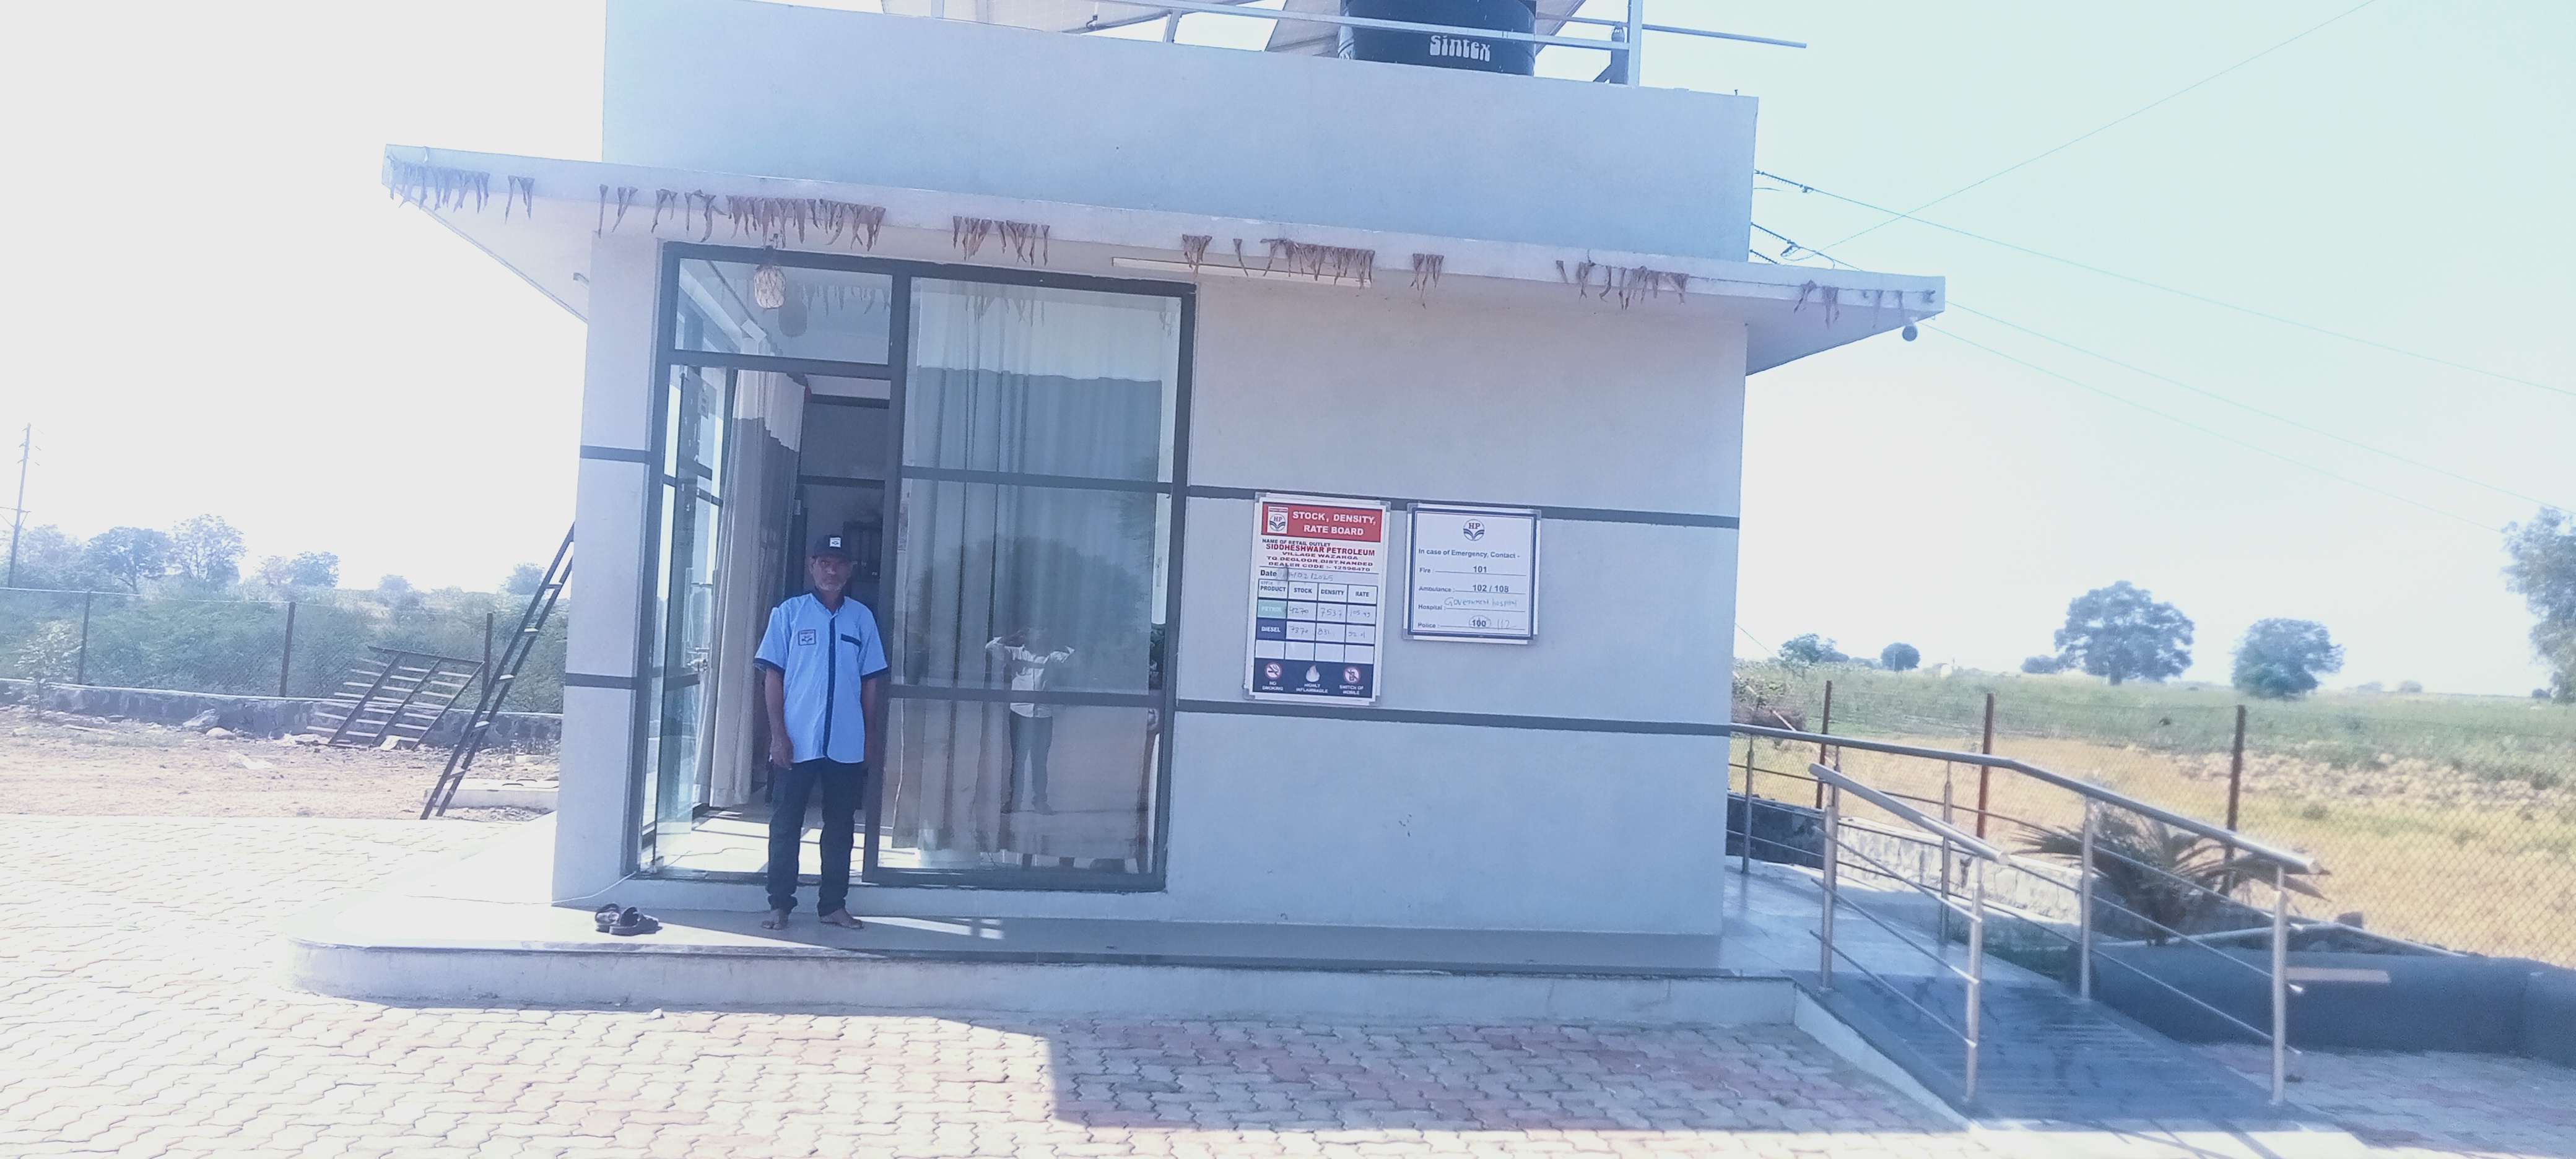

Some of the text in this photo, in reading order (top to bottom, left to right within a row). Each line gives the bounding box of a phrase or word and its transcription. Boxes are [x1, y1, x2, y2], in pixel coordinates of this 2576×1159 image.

[1430, 34, 1490, 62] Sintex
[1292, 511, 1376, 525] STOCK, DENSITY,
[1303, 524, 1364, 536] RATE BOARD
[1266, 544, 1375, 556] SIDDHESHWAR PETROLEUM
[1473, 584, 1487, 593] 102
[1495, 585, 1509, 593] 108
[1471, 619, 1486, 627] 100
